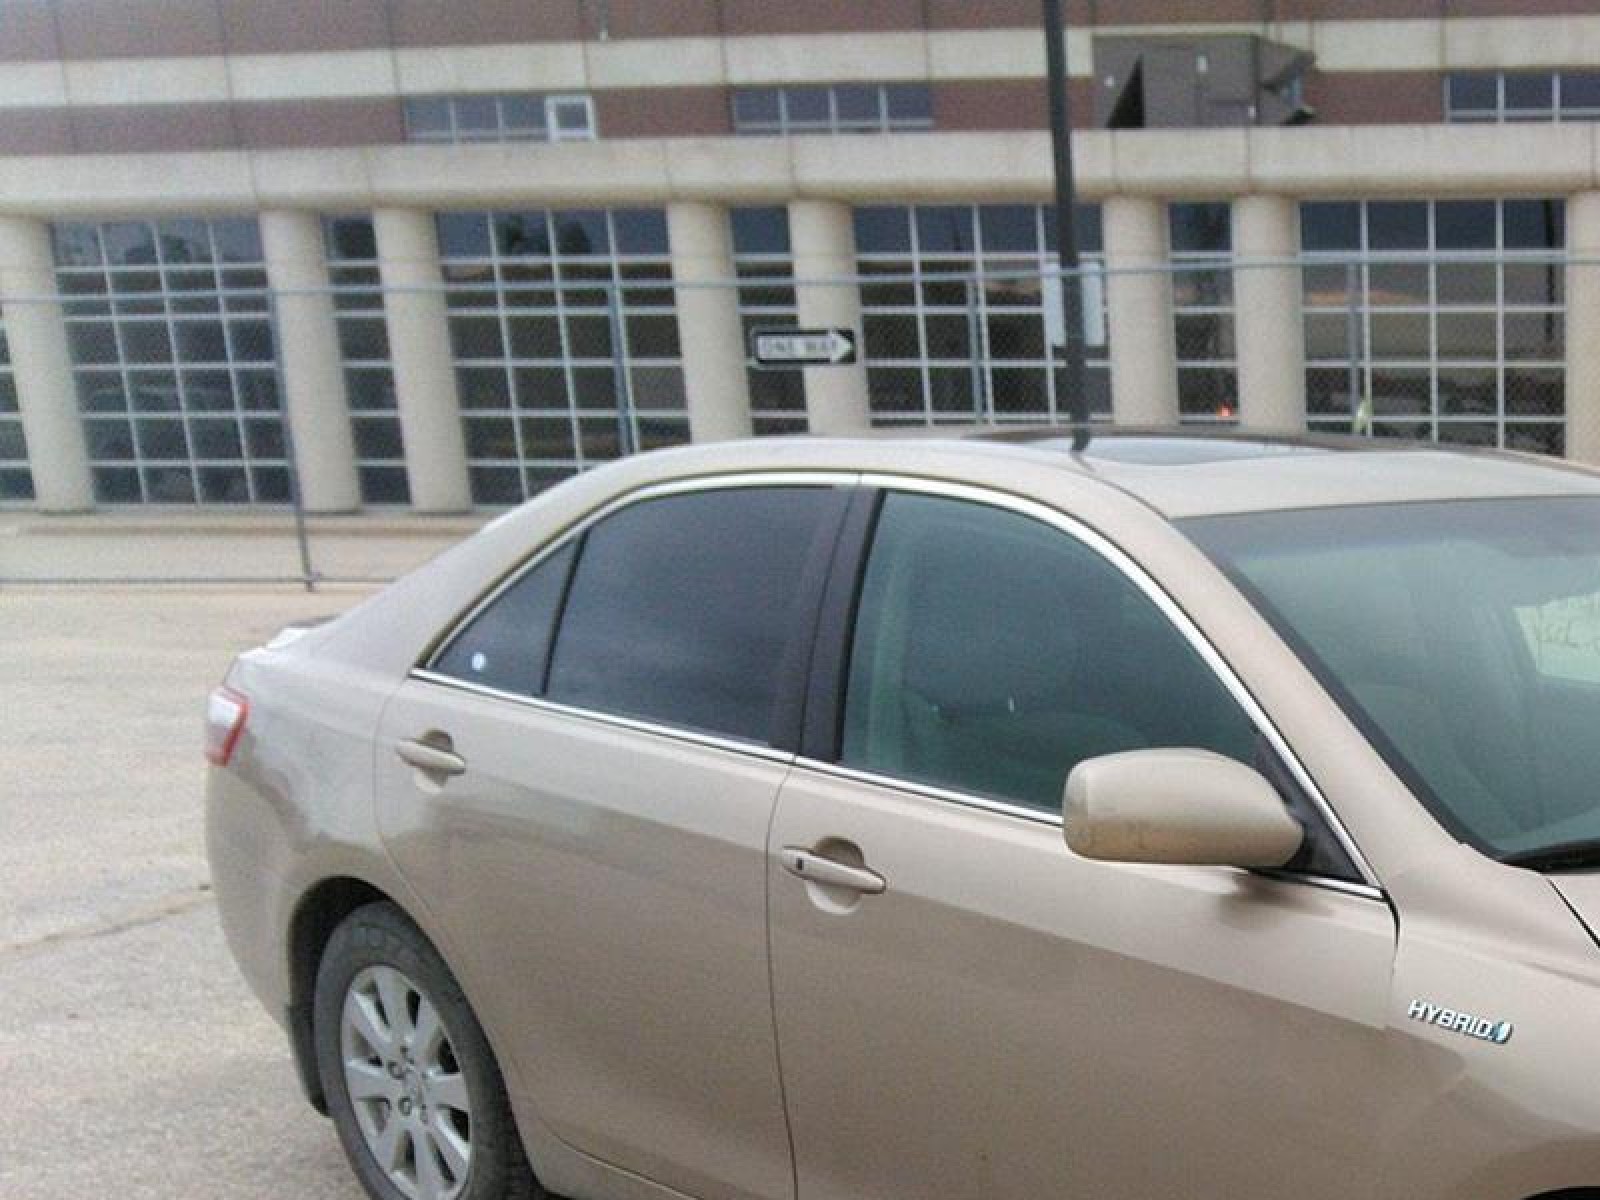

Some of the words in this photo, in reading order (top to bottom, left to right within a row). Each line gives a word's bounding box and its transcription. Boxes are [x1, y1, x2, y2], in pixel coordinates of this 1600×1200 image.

[762, 336, 795, 354] ONE
[805, 336, 837, 354] WAY
[1407, 999, 1492, 1037] HYBRID
